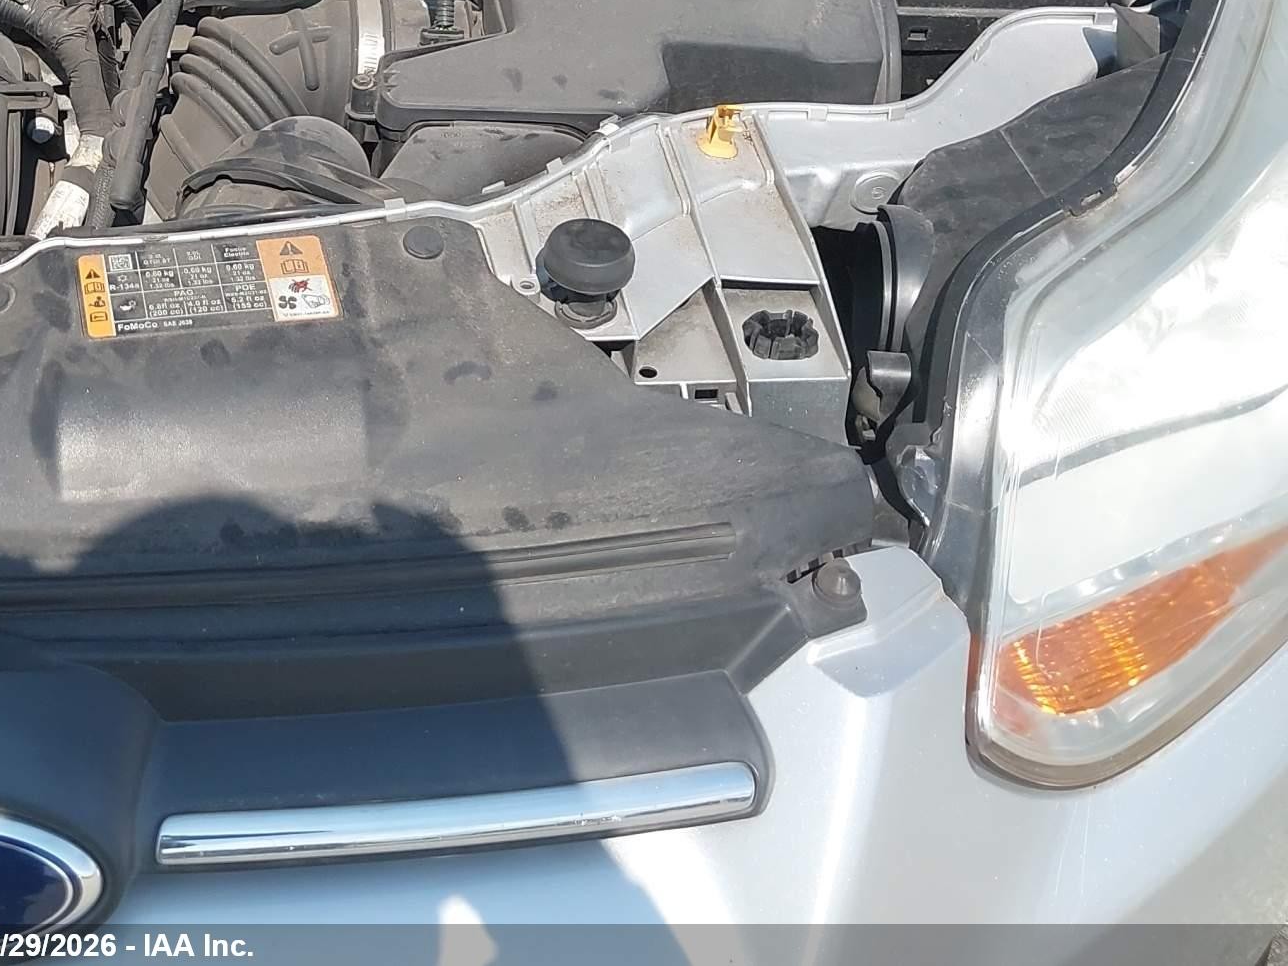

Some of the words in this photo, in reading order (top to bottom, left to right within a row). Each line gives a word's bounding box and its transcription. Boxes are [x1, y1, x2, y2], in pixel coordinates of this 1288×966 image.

[163, 270, 174, 278] kg
[201, 266, 212, 274] kg
[109, 282, 140, 292] R-134a
[118, 321, 158, 331] FoMoCo
